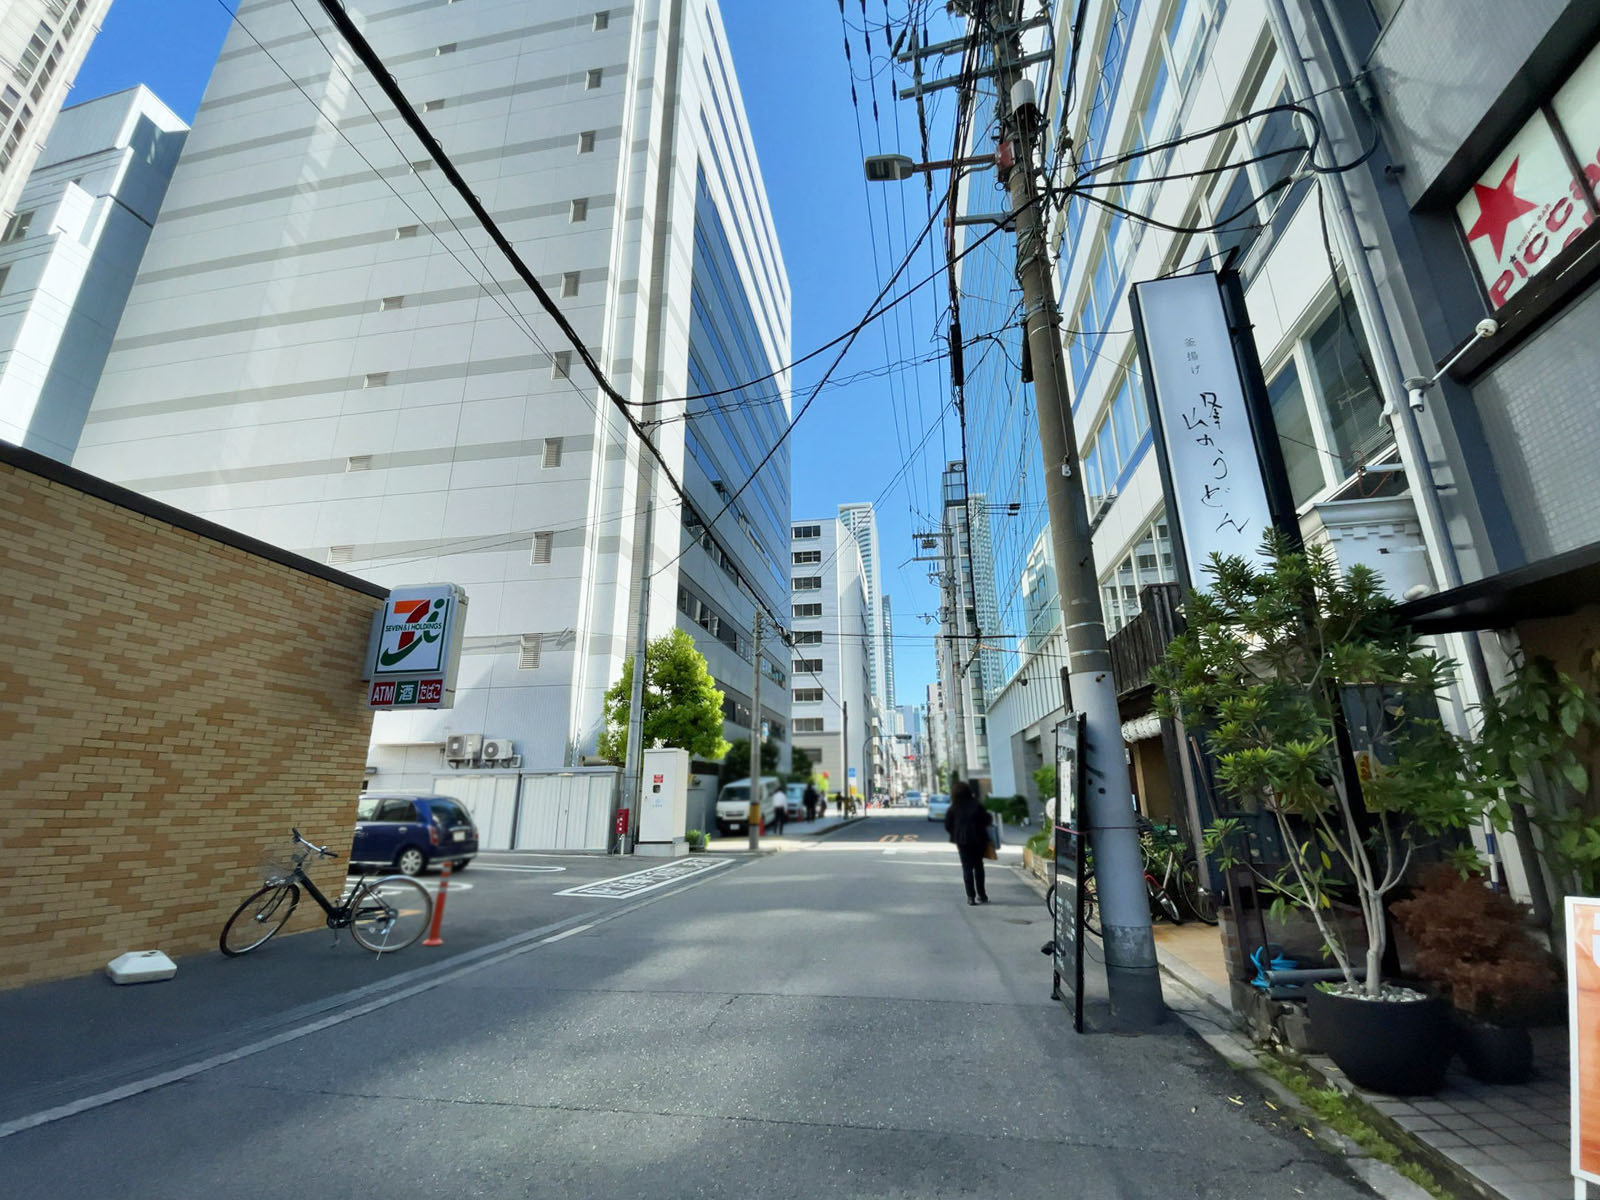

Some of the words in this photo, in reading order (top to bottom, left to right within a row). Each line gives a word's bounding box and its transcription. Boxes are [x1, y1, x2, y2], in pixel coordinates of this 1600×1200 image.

[411, 622, 442, 631] HOLDINGS
[372, 686, 394, 702] ATM
[399, 685, 415, 702] 酒
[420, 684, 441, 700] たばこ
